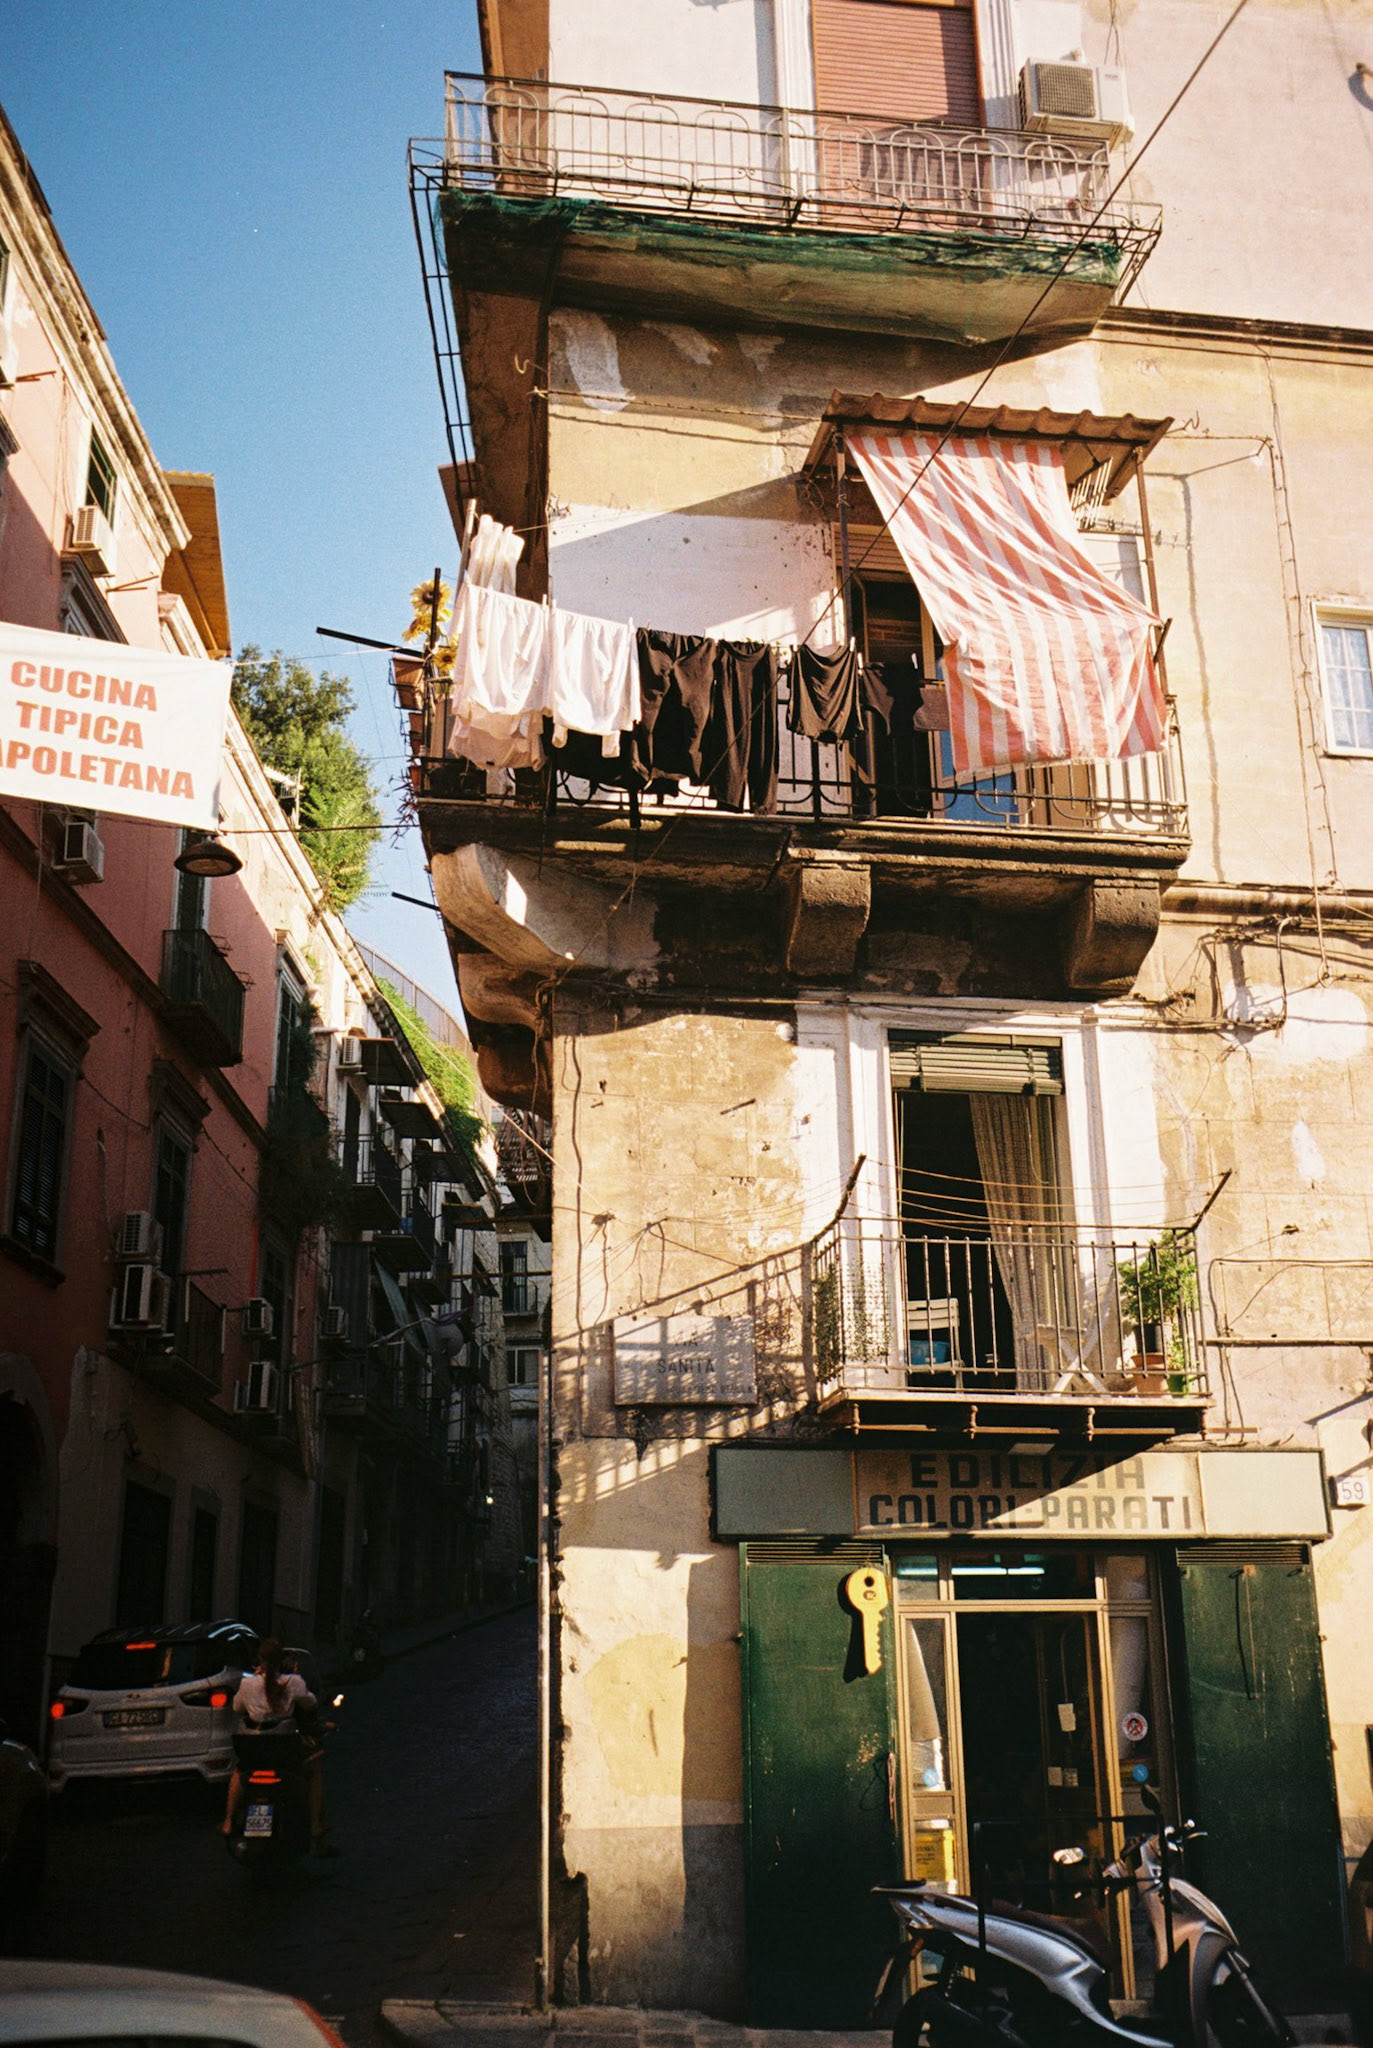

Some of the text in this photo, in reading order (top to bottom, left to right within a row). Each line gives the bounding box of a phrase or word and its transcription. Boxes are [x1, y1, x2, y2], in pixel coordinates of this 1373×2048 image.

[11, 661, 157, 712] CUCINA
[16, 701, 144, 749] TIPICA
[911, 1453, 1145, 1489] EDILIZIA
[1341, 1481, 1364, 1500] 59
[870, 1494, 1192, 1530] COLORI PARATI
